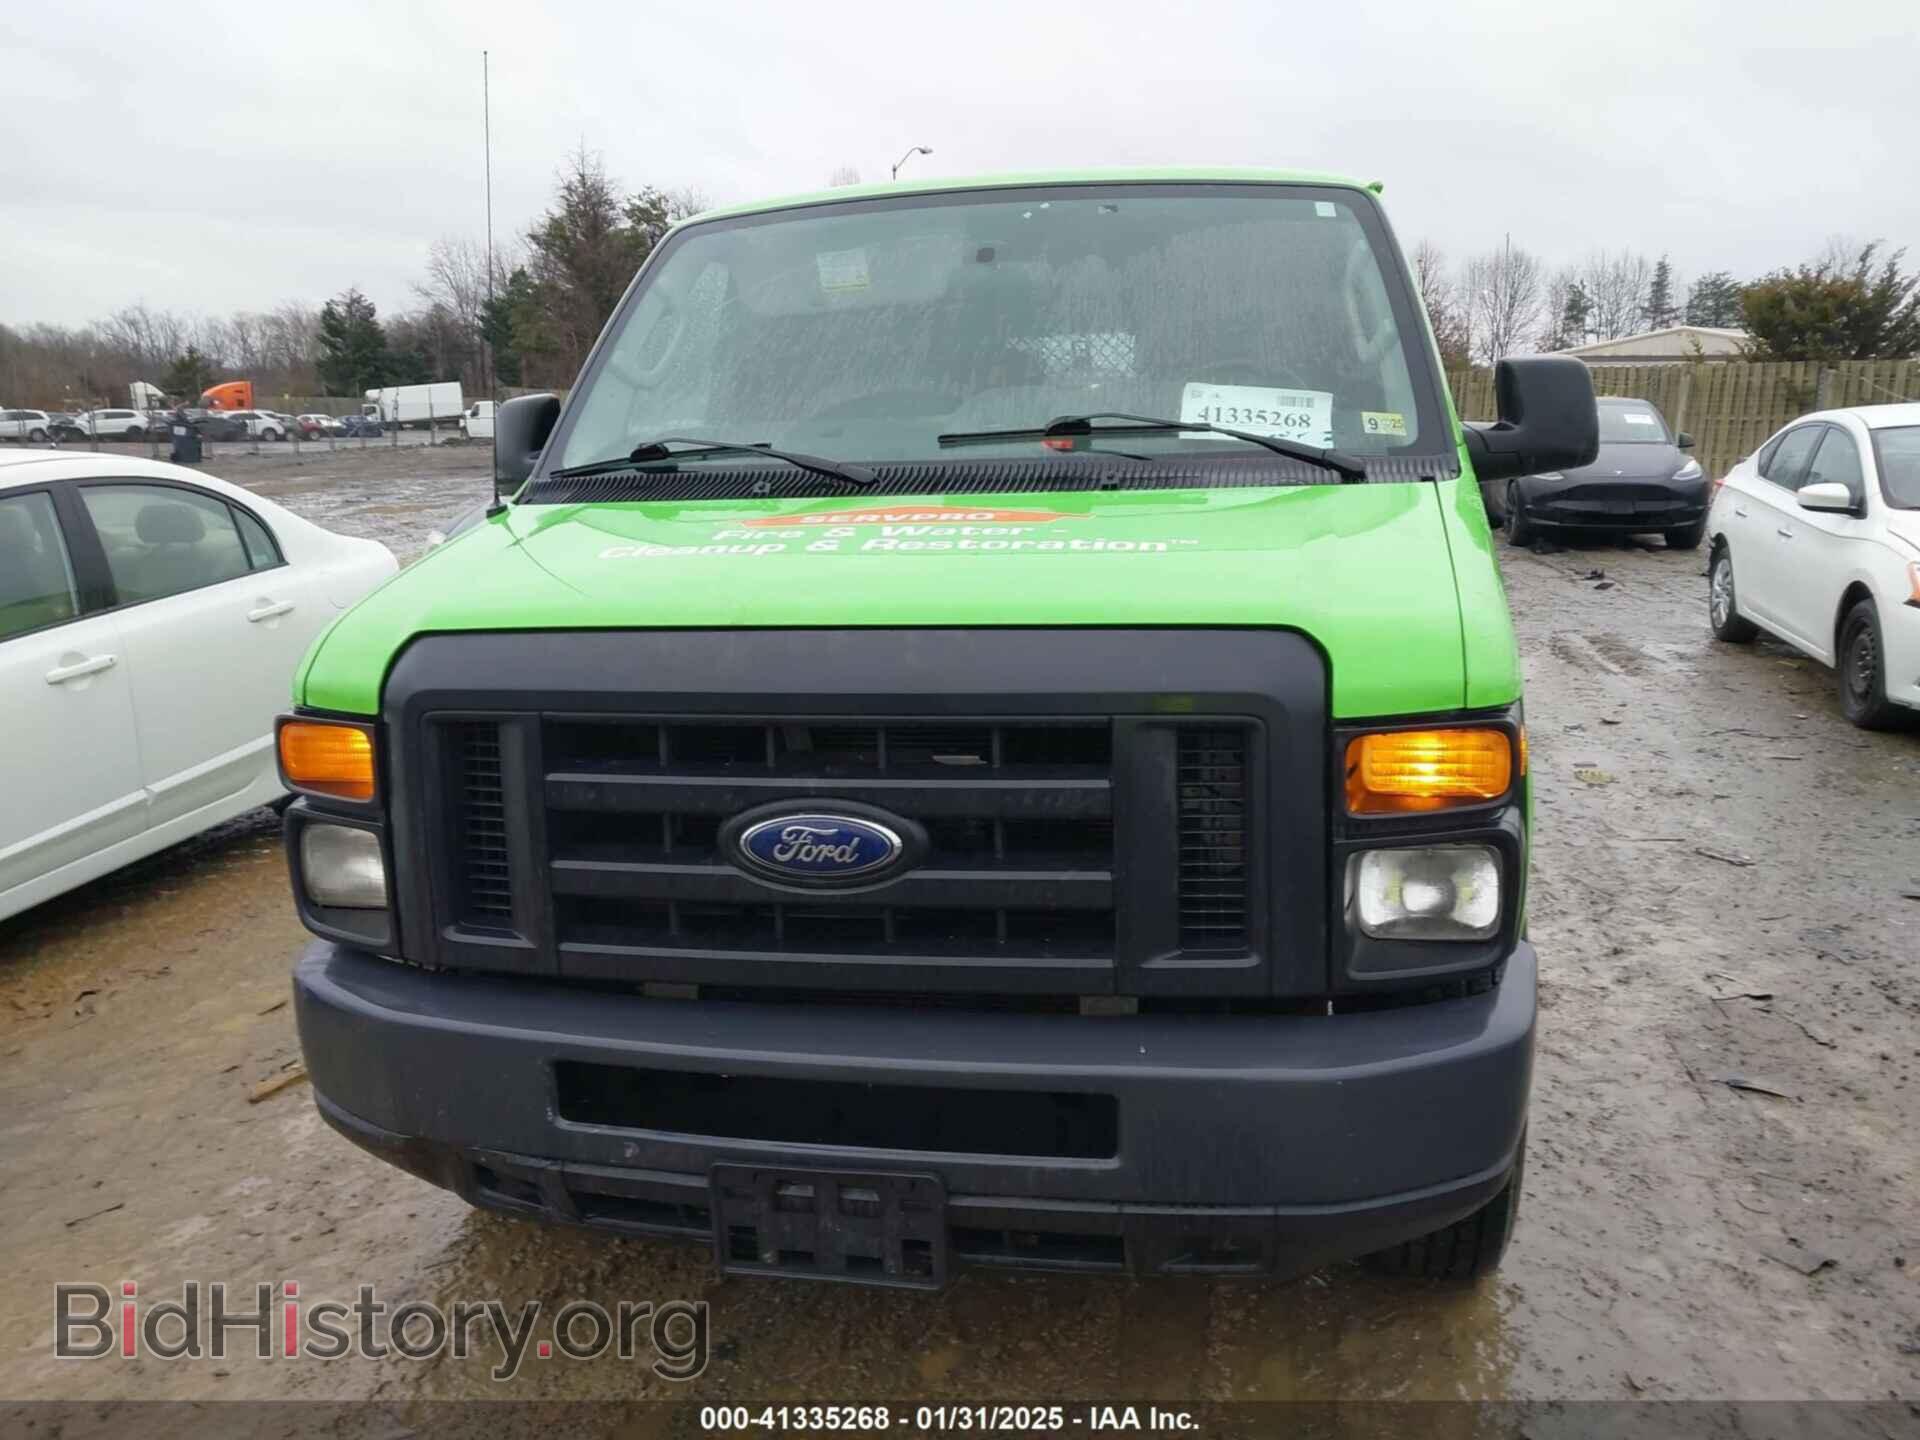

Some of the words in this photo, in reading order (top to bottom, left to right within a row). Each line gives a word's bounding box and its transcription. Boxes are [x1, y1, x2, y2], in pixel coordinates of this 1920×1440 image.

[1197, 406, 1312, 428] 41335268
[1367, 417, 1378, 430] 9
[799, 512, 995, 524] SERVPRO
[712, 529, 805, 541] Fire
[823, 527, 856, 537] &
[881, 525, 1036, 536] Water
[598, 543, 787, 559] Cleanup
[805, 539, 841, 552] &
[773, 825, 861, 863] Ford
